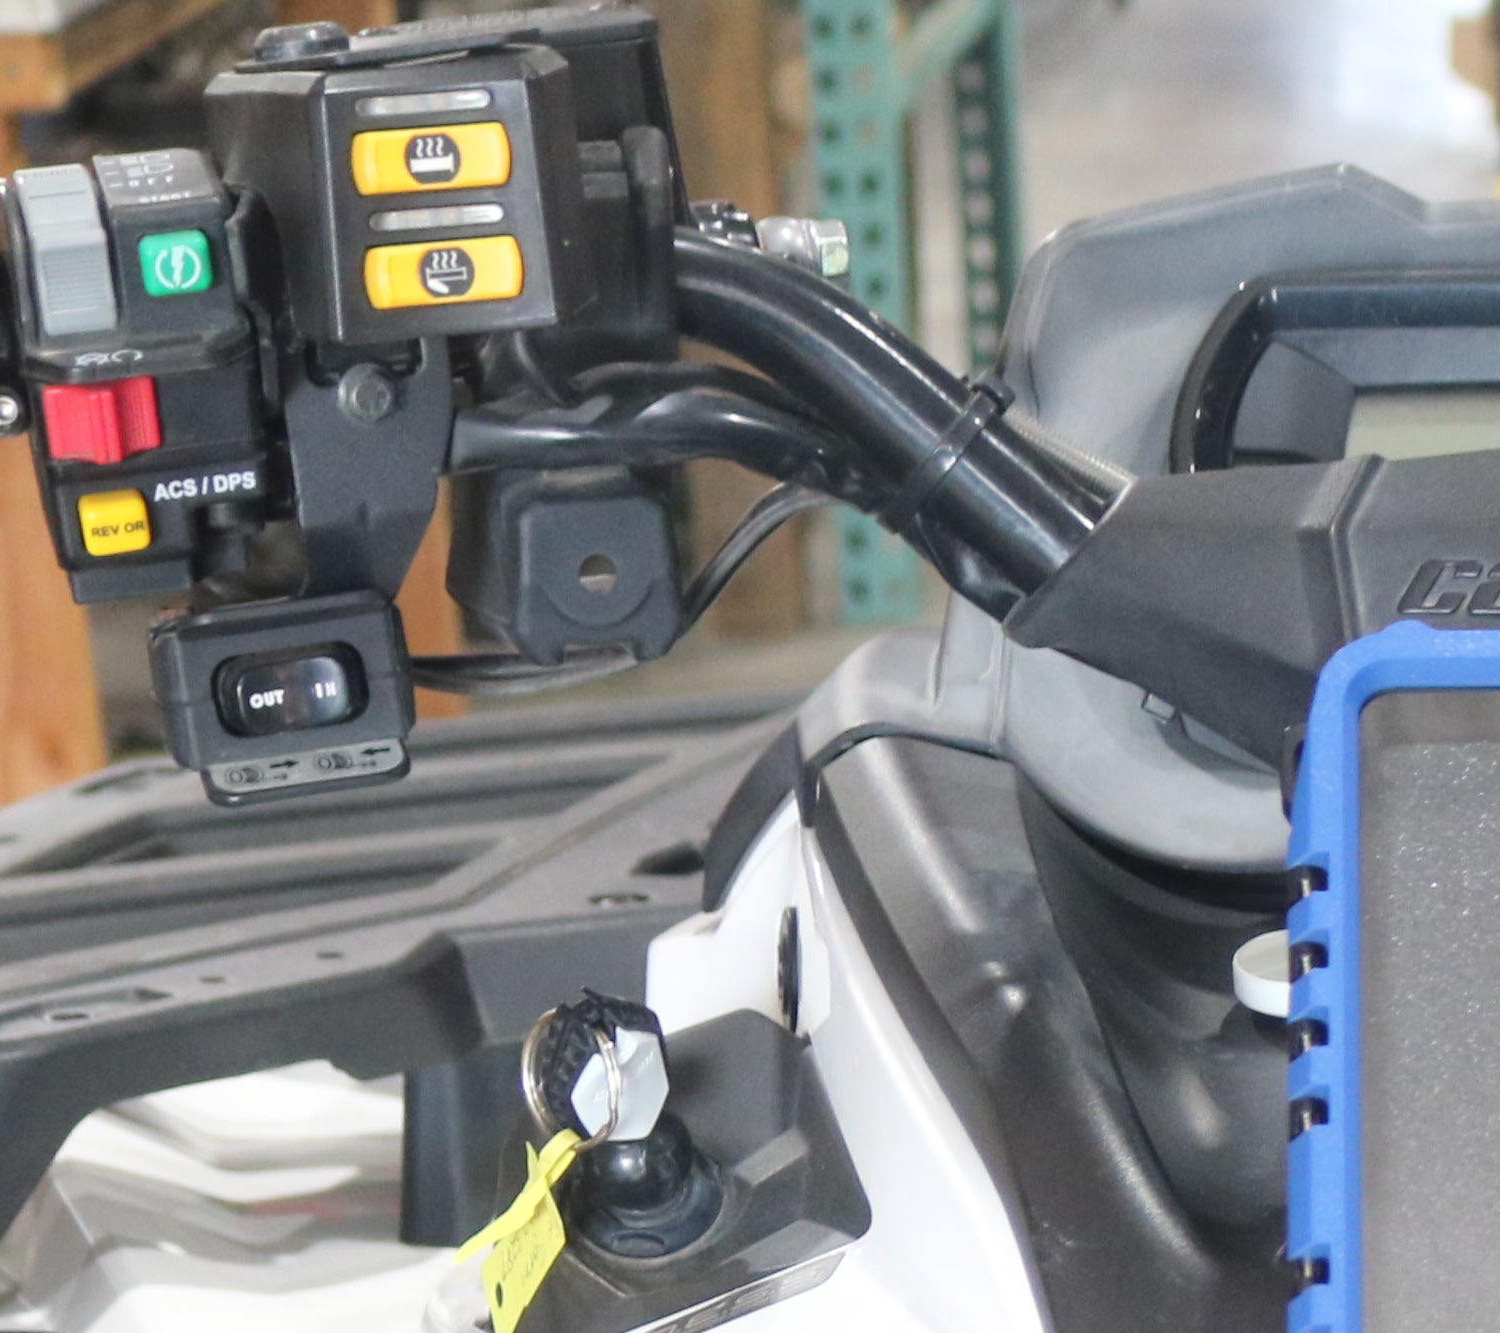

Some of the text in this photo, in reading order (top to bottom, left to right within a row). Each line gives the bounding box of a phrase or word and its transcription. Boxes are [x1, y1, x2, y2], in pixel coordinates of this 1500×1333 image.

[154, 478, 198, 503] ACS
[212, 470, 257, 494] DPS
[91, 524, 120, 538] REV
[249, 680, 337, 710] OUT IN
